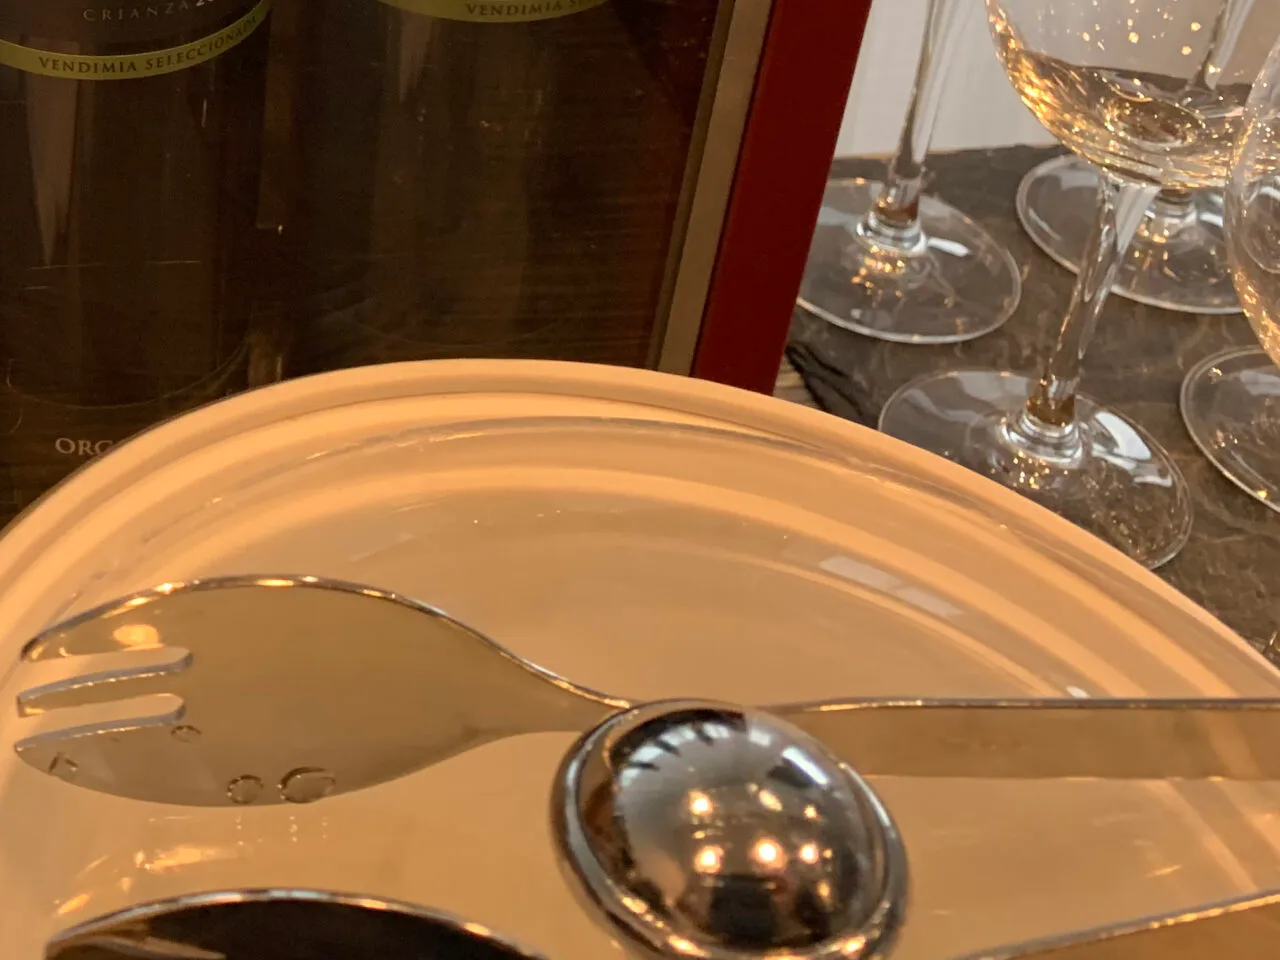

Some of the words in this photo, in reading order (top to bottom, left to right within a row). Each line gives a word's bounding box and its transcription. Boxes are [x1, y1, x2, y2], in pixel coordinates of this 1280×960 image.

[82, 0, 189, 22] CRIANZA
[465, 0, 564, 18] VENDIMIA
[37, 55, 138, 75] VENDIMIA
